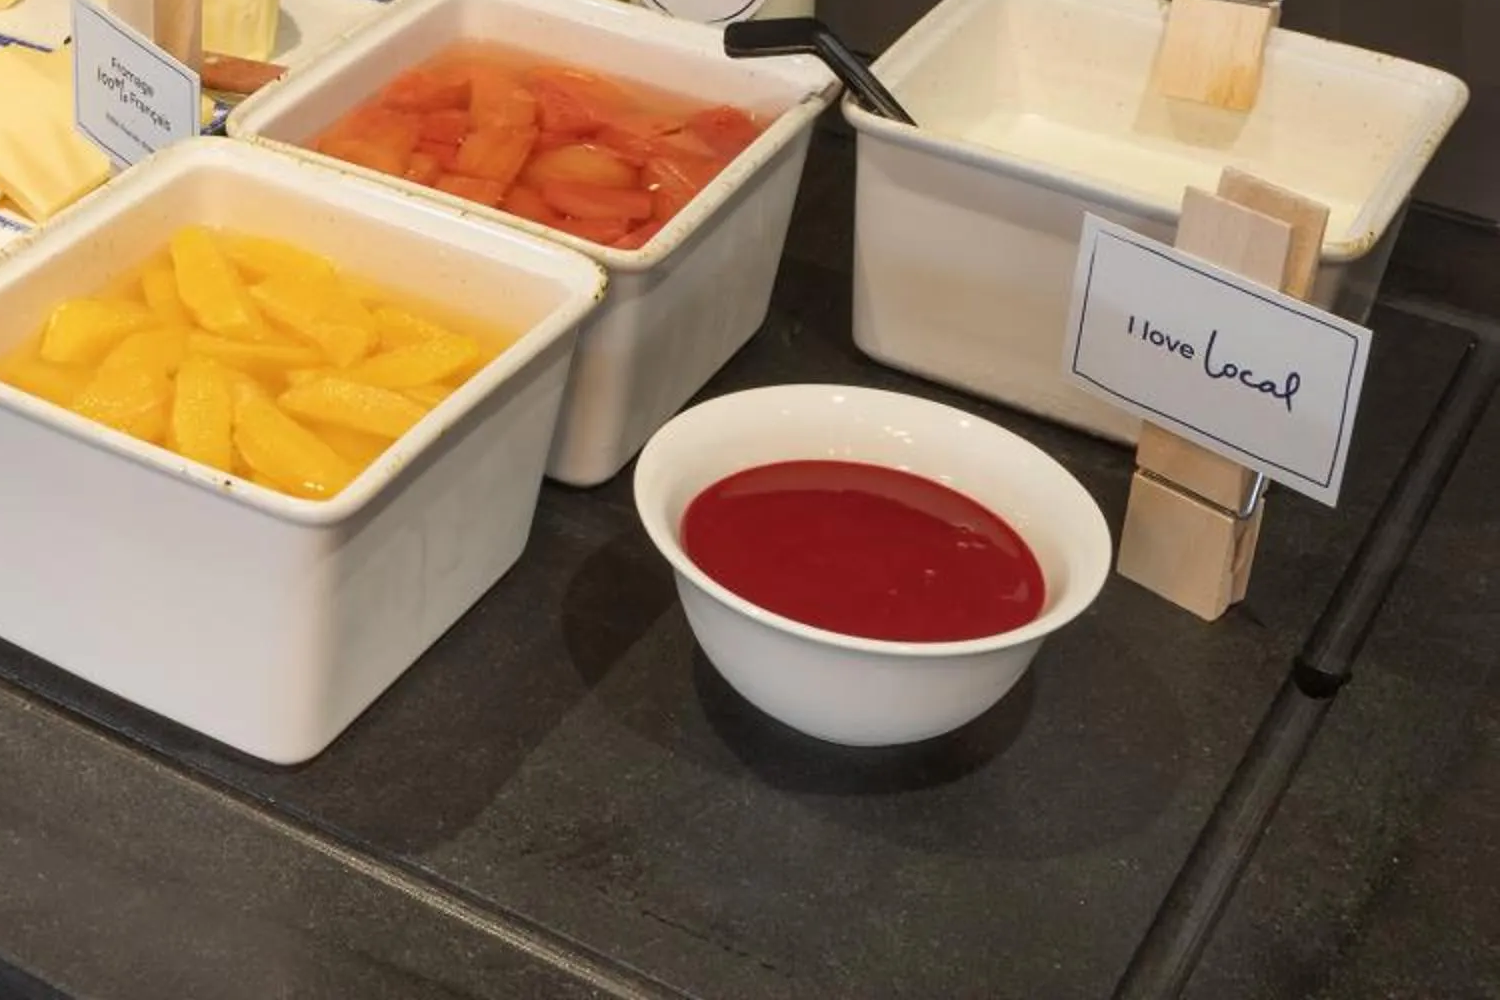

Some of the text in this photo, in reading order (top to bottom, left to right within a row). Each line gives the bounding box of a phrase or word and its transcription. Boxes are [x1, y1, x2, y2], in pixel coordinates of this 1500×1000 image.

[130, 91, 171, 132] Français
[1127, 315, 1135, 334] I
[1141, 320, 1195, 359] love
